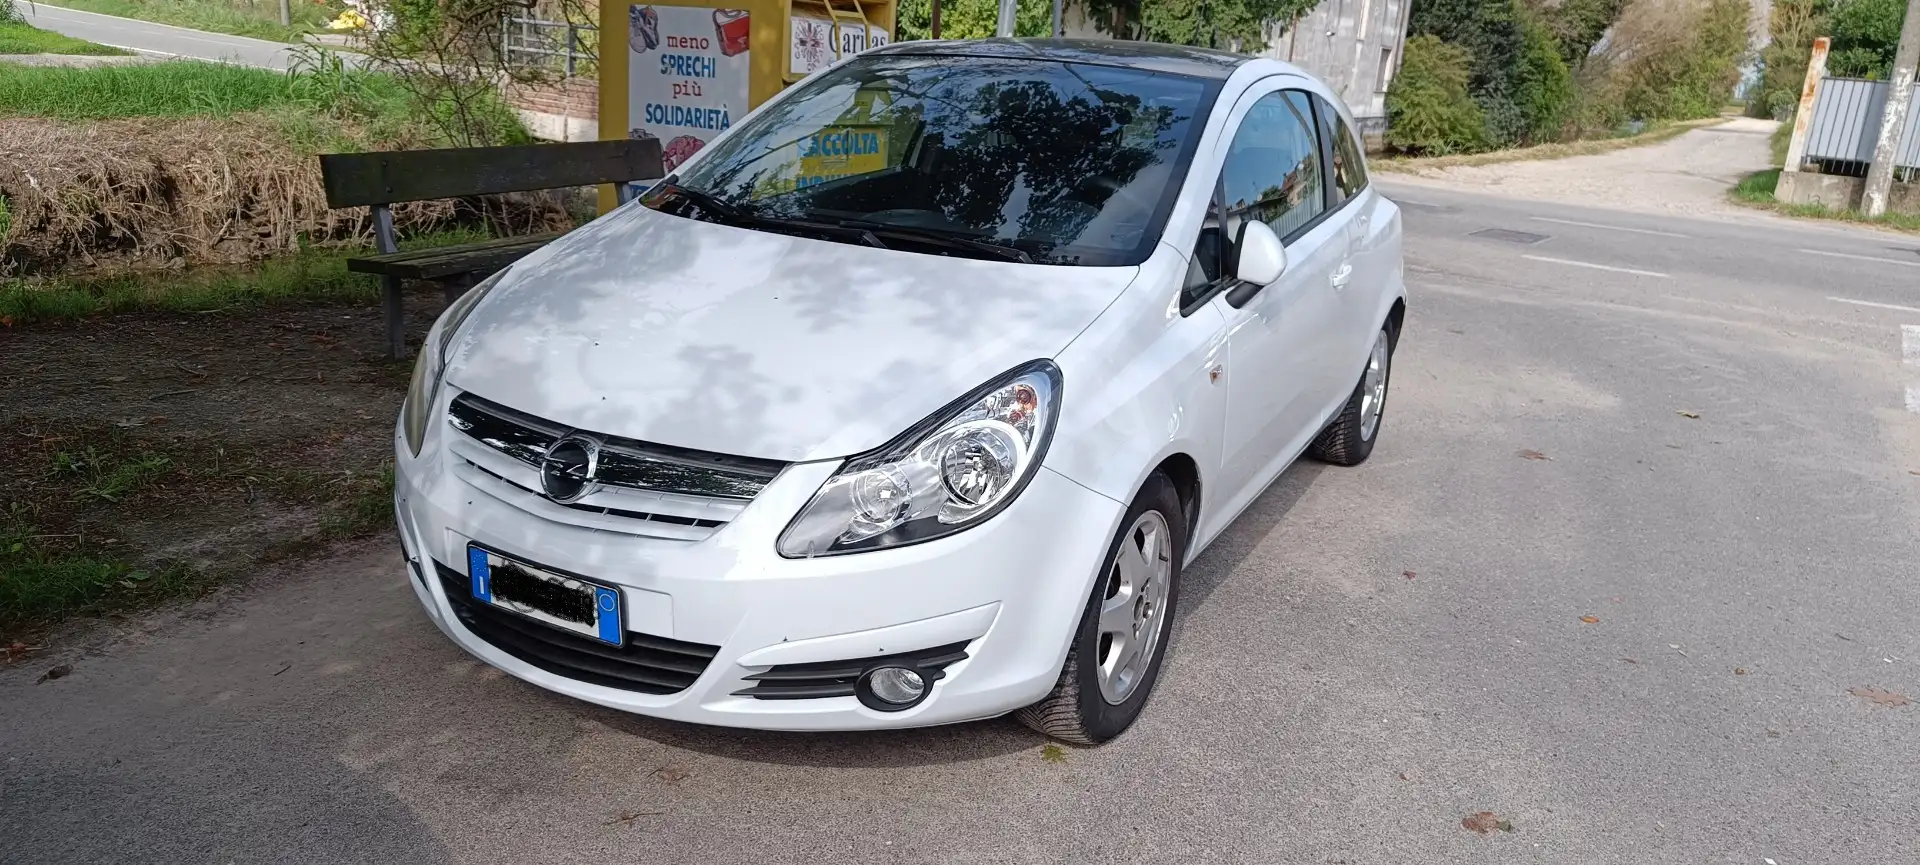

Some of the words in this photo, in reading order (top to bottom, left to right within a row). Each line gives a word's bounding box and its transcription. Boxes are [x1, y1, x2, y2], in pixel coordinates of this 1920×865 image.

[666, 35, 710, 50] meno
[828, 24, 887, 54] Carias
[660, 53, 716, 78] SPRECHI
[672, 80, 703, 99] più
[645, 103, 730, 131] SOLIDARIETÀ
[479, 576, 484, 594] I
